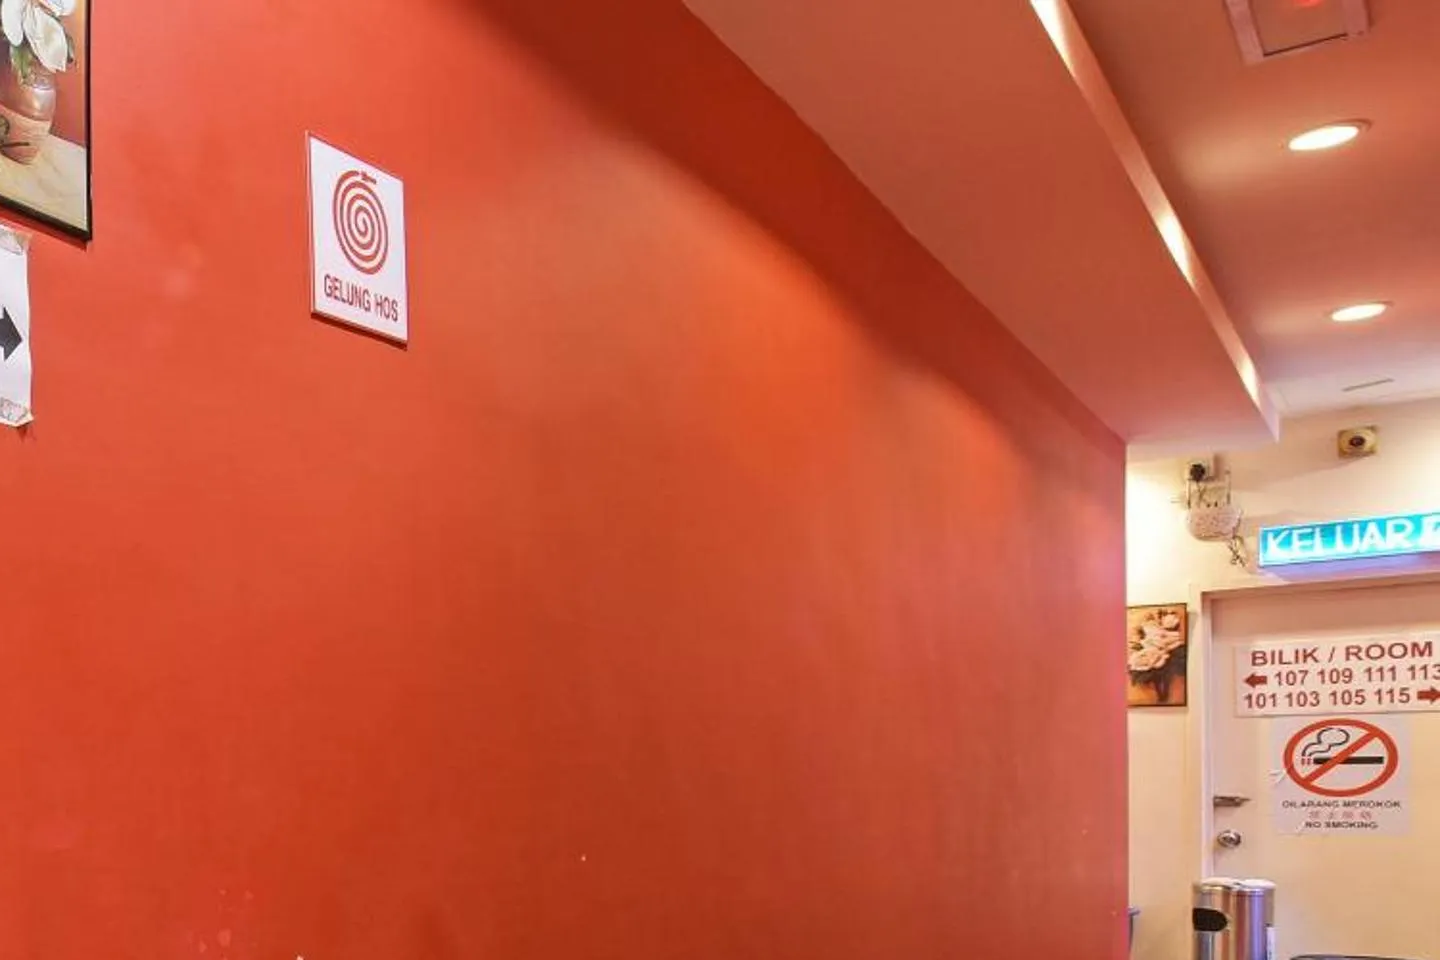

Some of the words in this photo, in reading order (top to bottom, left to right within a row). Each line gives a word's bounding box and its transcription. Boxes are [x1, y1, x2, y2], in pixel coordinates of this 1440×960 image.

[323, 273, 372, 313] GELUNG
[374, 293, 399, 323] HOS
[1265, 518, 1415, 556] KELUAR
[1250, 646, 1320, 667] BILIK
[1328, 646, 1336, 663] /
[1344, 641, 1434, 662] ROOM
[1274, 669, 1309, 687] 107
[1316, 668, 1354, 685] 109
[1363, 665, 1398, 683] 111
[1406, 663, 1440, 681] 113
[1244, 692, 1277, 709] 101
[1284, 690, 1321, 708] 103
[1328, 688, 1367, 707] 105
[1373, 686, 1411, 705] 115
[1305, 820, 1321, 829] NO
[1324, 820, 1379, 829] SMOKING
